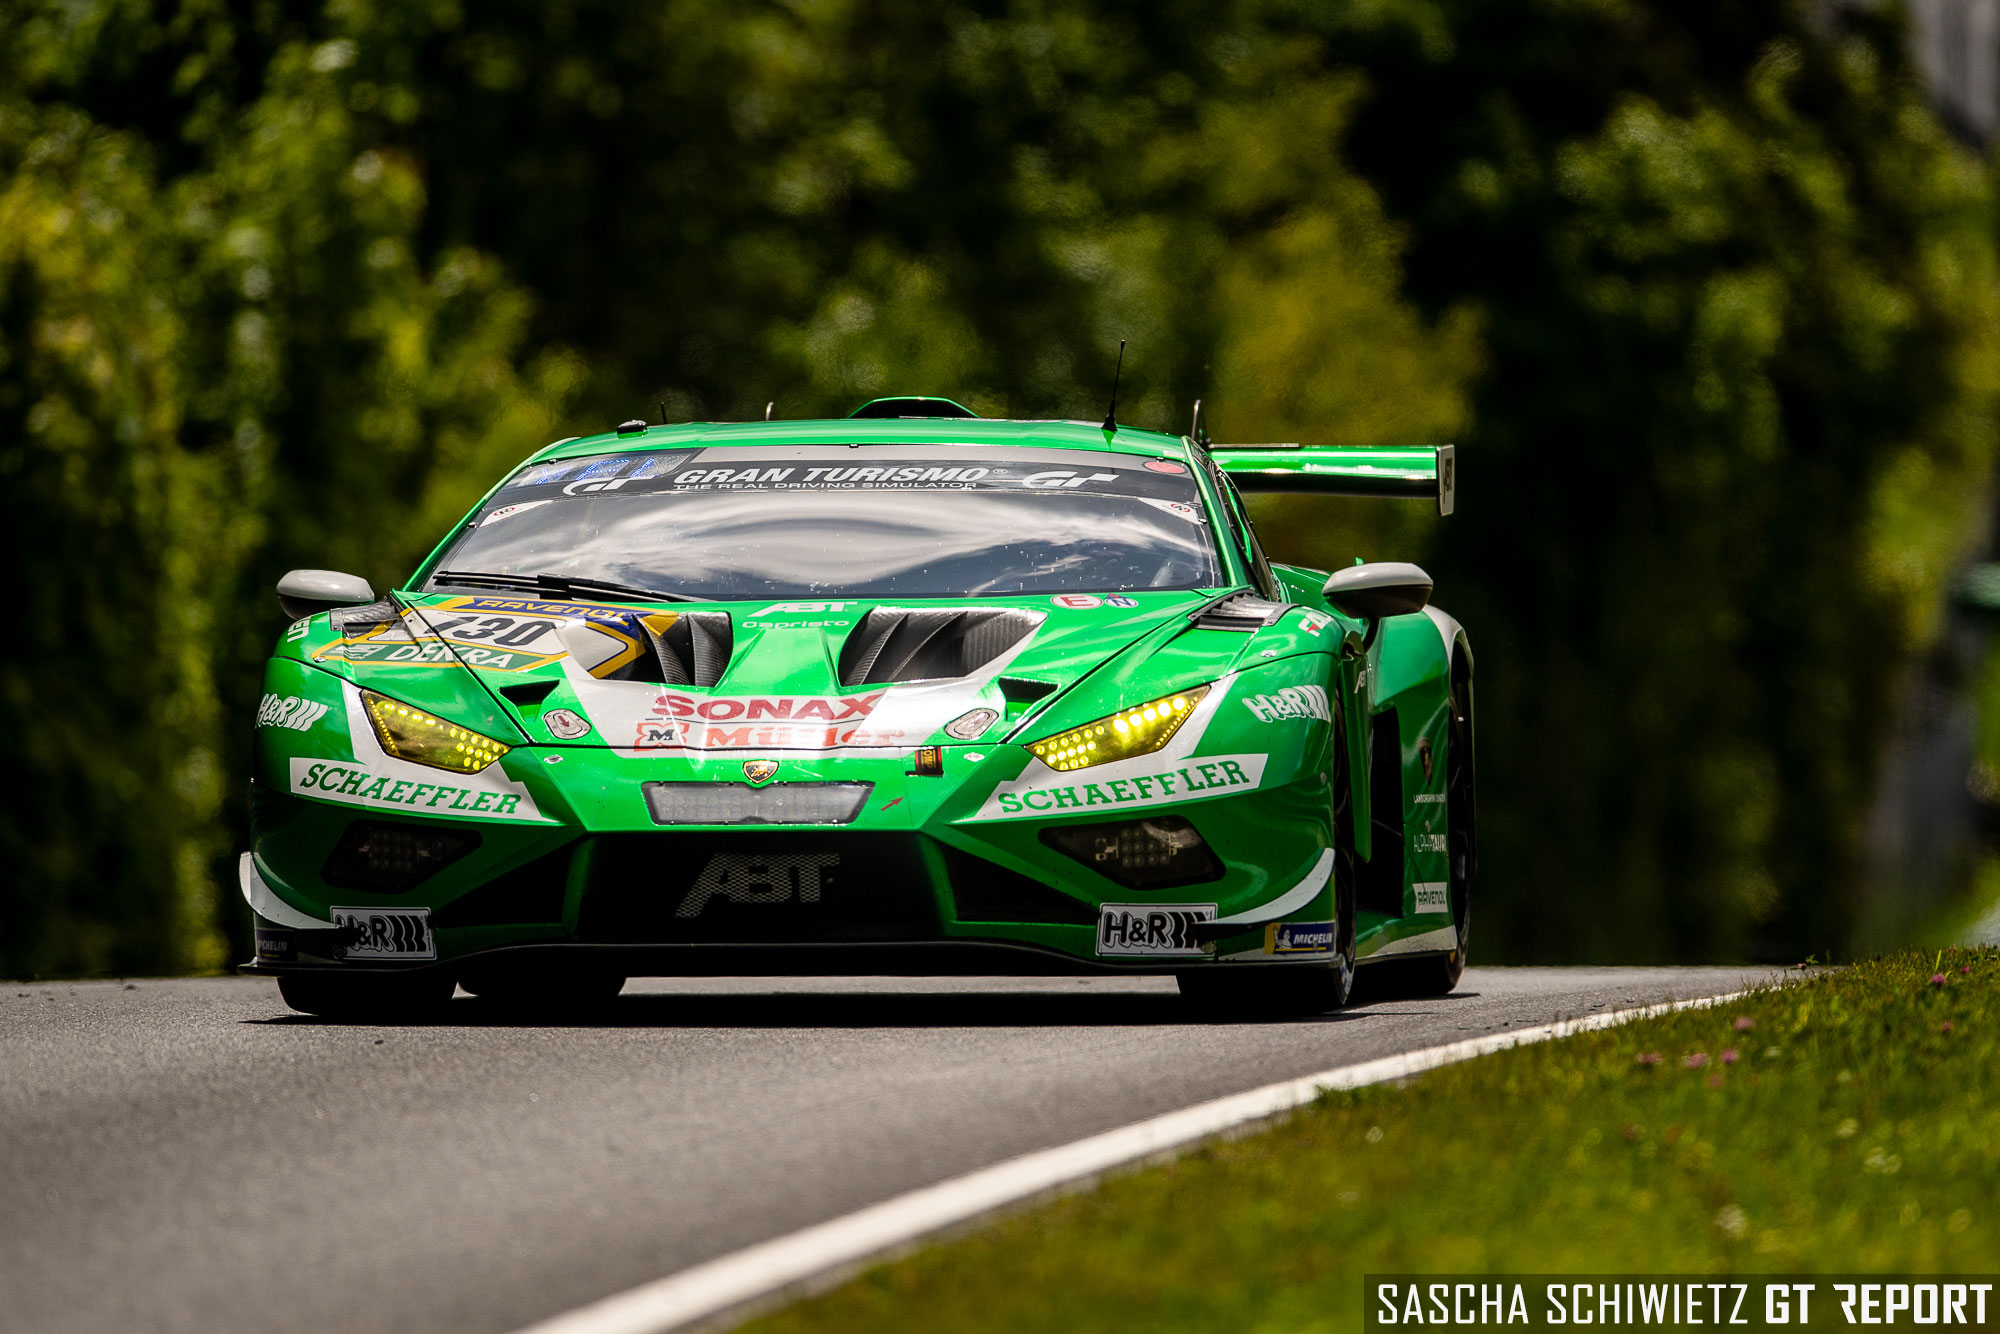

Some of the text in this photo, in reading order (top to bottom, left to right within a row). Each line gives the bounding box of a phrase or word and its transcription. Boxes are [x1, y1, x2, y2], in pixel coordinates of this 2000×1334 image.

[673, 467, 796, 484] GRAN
[746, 601, 858, 617] ABT
[383, 642, 514, 669] DEKRA
[255, 693, 302, 728] H&R
[651, 693, 887, 721] SONAX
[1242, 688, 1315, 723] H&R
[647, 729, 675, 741] M
[299, 763, 522, 815] SCHAEFFLER
[998, 759, 1250, 814] SCHAEFFLER
[674, 852, 841, 918] ABT
[1102, 911, 1173, 949] H&R
